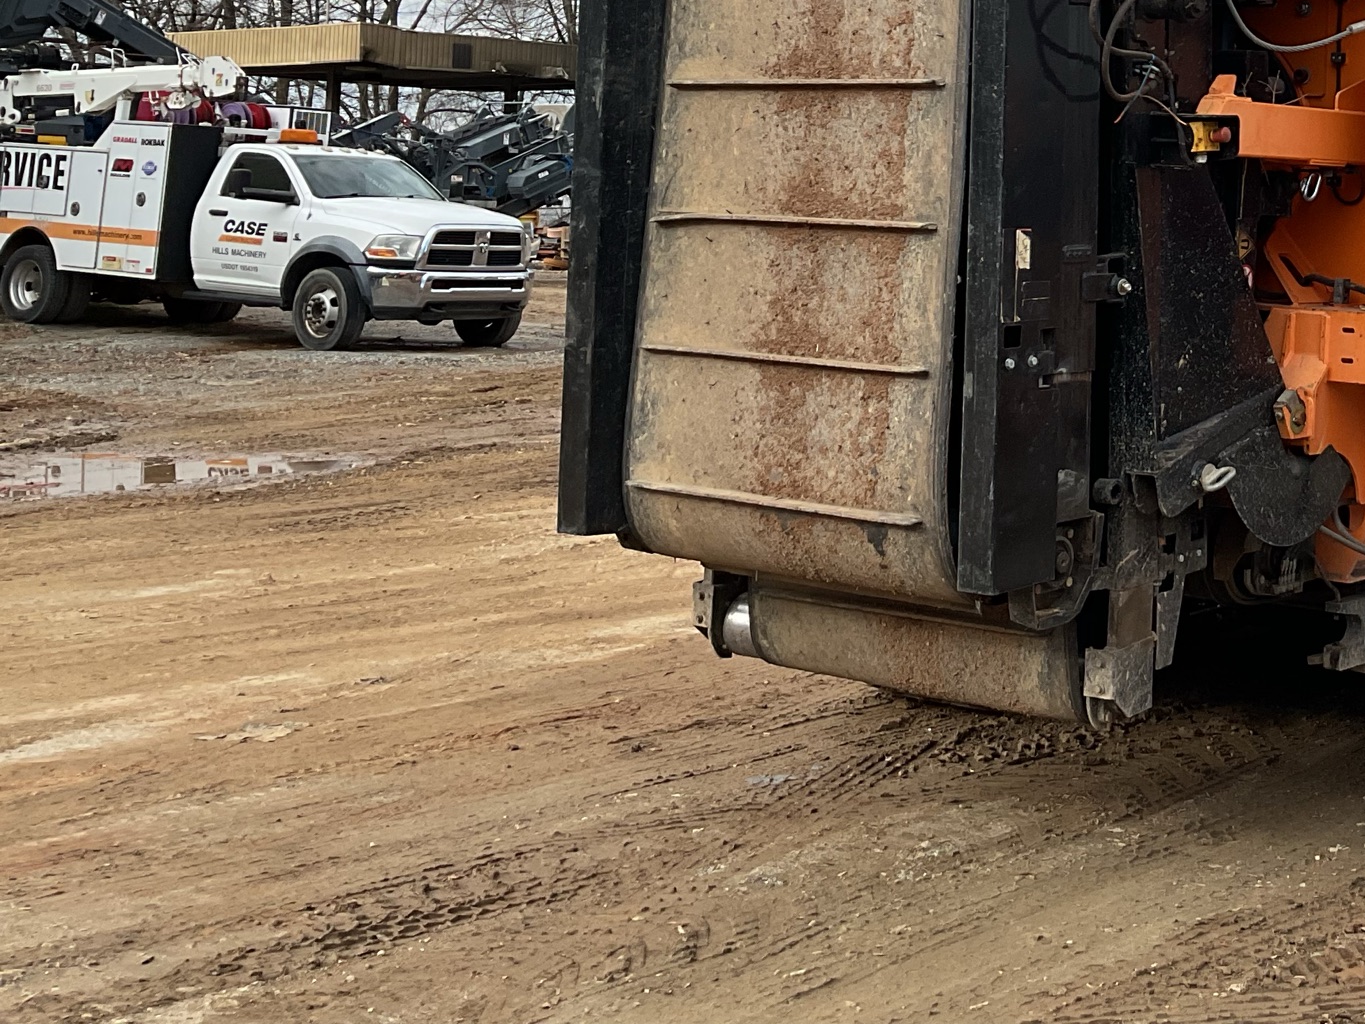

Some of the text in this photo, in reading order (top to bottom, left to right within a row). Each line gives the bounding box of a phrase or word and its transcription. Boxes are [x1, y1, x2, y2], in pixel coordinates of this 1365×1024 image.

[223, 219, 269, 236] CASE
[212, 247, 267, 259] HILLS MACHINERY
[221, 263, 239, 271] USDOT
